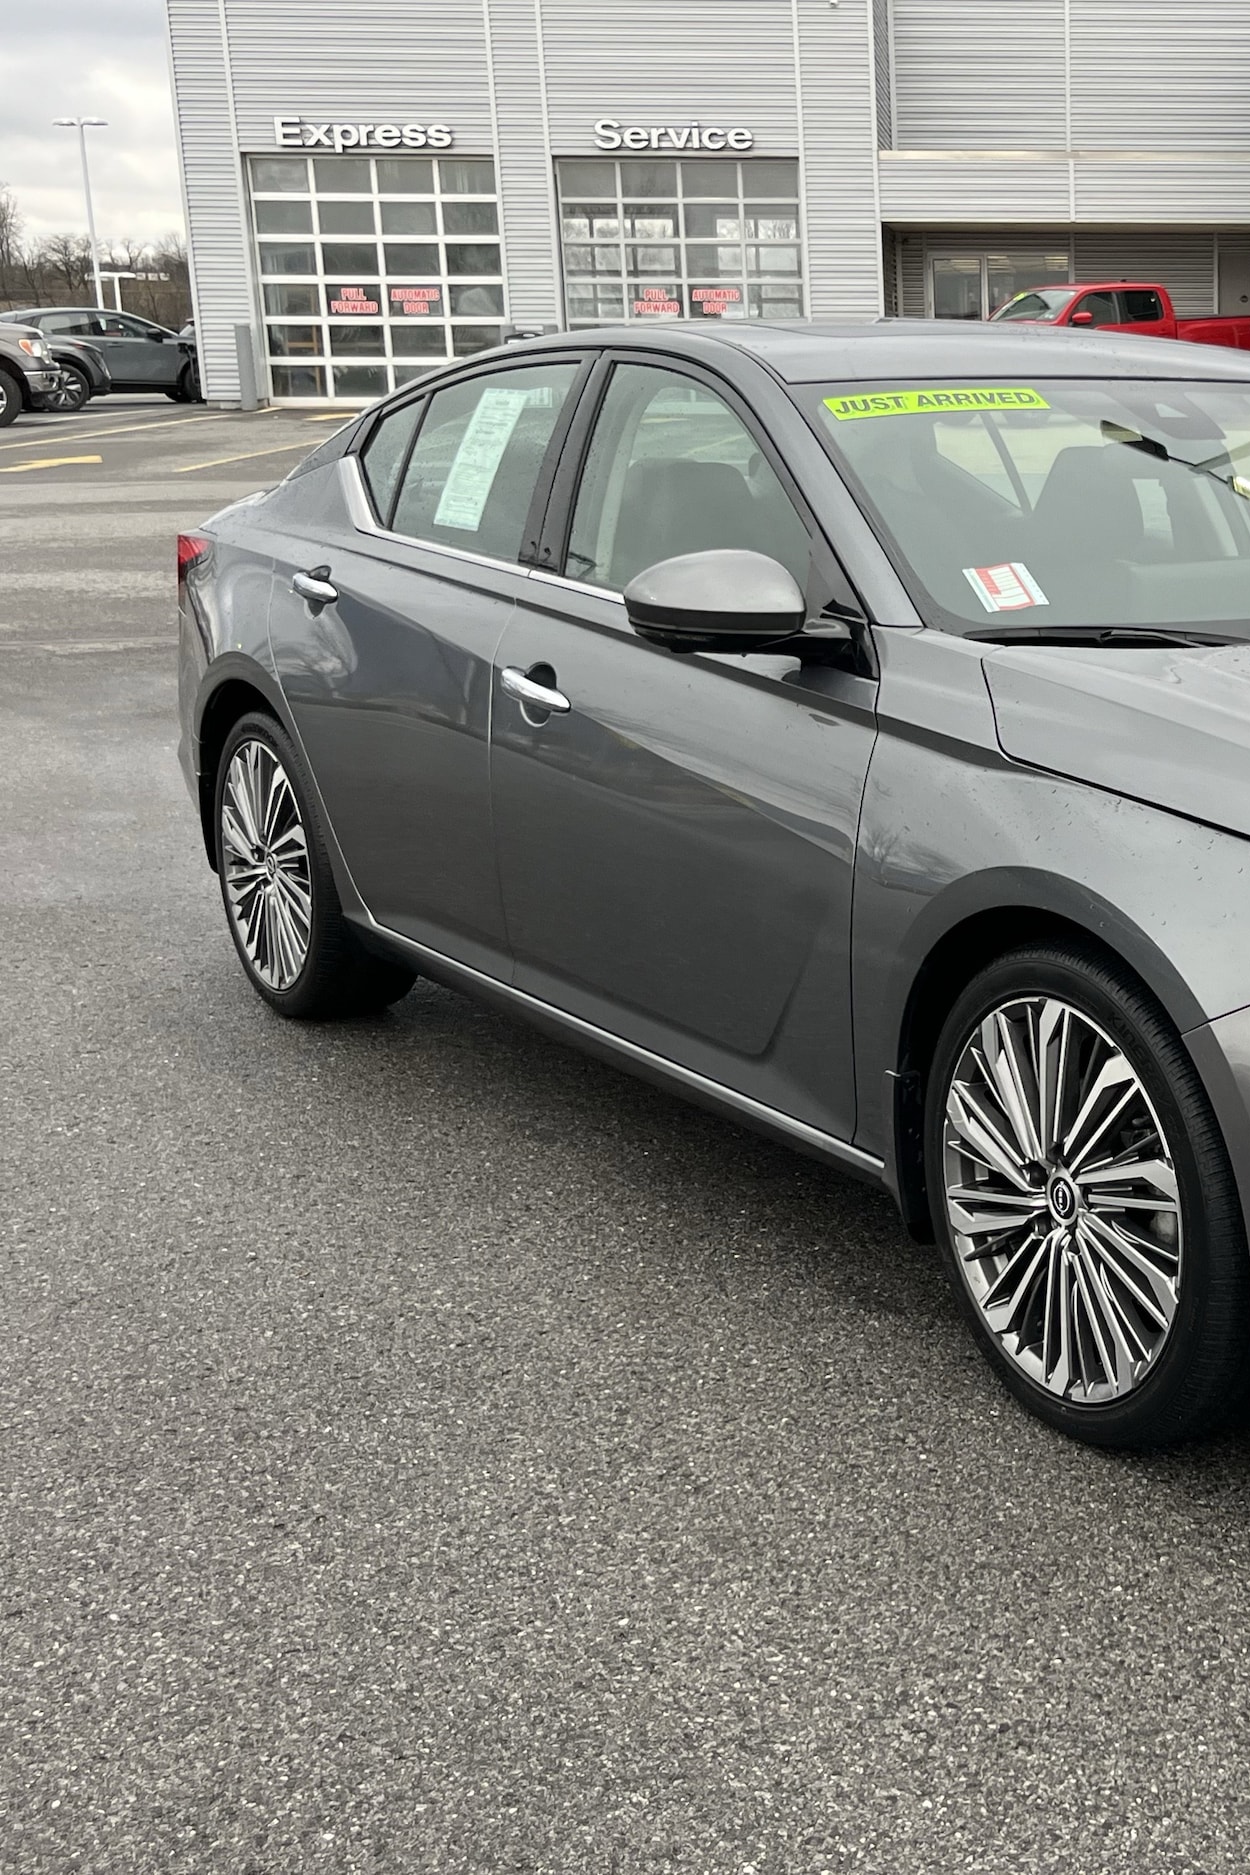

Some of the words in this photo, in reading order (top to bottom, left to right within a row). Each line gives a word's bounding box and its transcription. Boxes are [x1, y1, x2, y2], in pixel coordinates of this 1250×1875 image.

[273, 116, 453, 153] Express
[594, 119, 753, 150] Service
[341, 288, 367, 300] PULL
[391, 289, 440, 301] AUTOMATIC
[643, 288, 669, 301] PULL
[692, 289, 740, 301] AUTOMATIC
[331, 301, 378, 313] FORWARD
[403, 302, 429, 314] DOOR
[633, 301, 679, 314] FORWARD
[703, 302, 728, 314] DOOR
[835, 396, 905, 414] JUST
[917, 392, 1036, 408] ARRIVED
